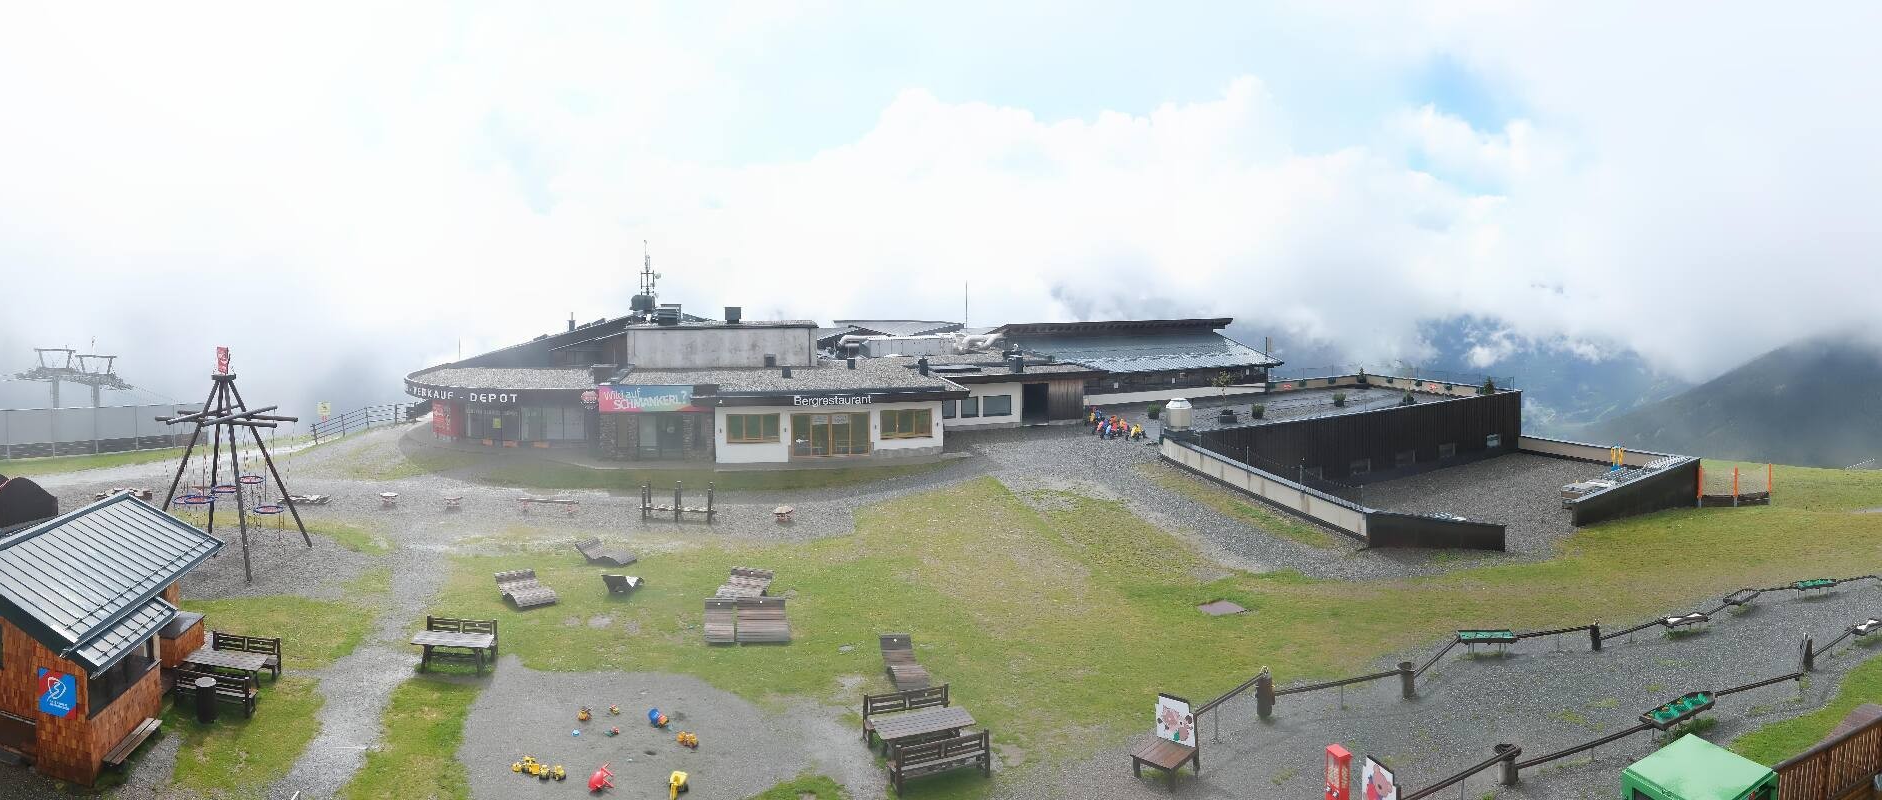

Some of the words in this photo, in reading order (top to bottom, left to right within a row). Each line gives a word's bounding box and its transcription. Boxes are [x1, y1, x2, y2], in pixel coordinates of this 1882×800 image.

[413, 386, 454, 400] VERKAUF
[469, 392, 518, 403] DEPOT
[626, 387, 641, 399] auf
[794, 395, 871, 407] Bergrestaurant
